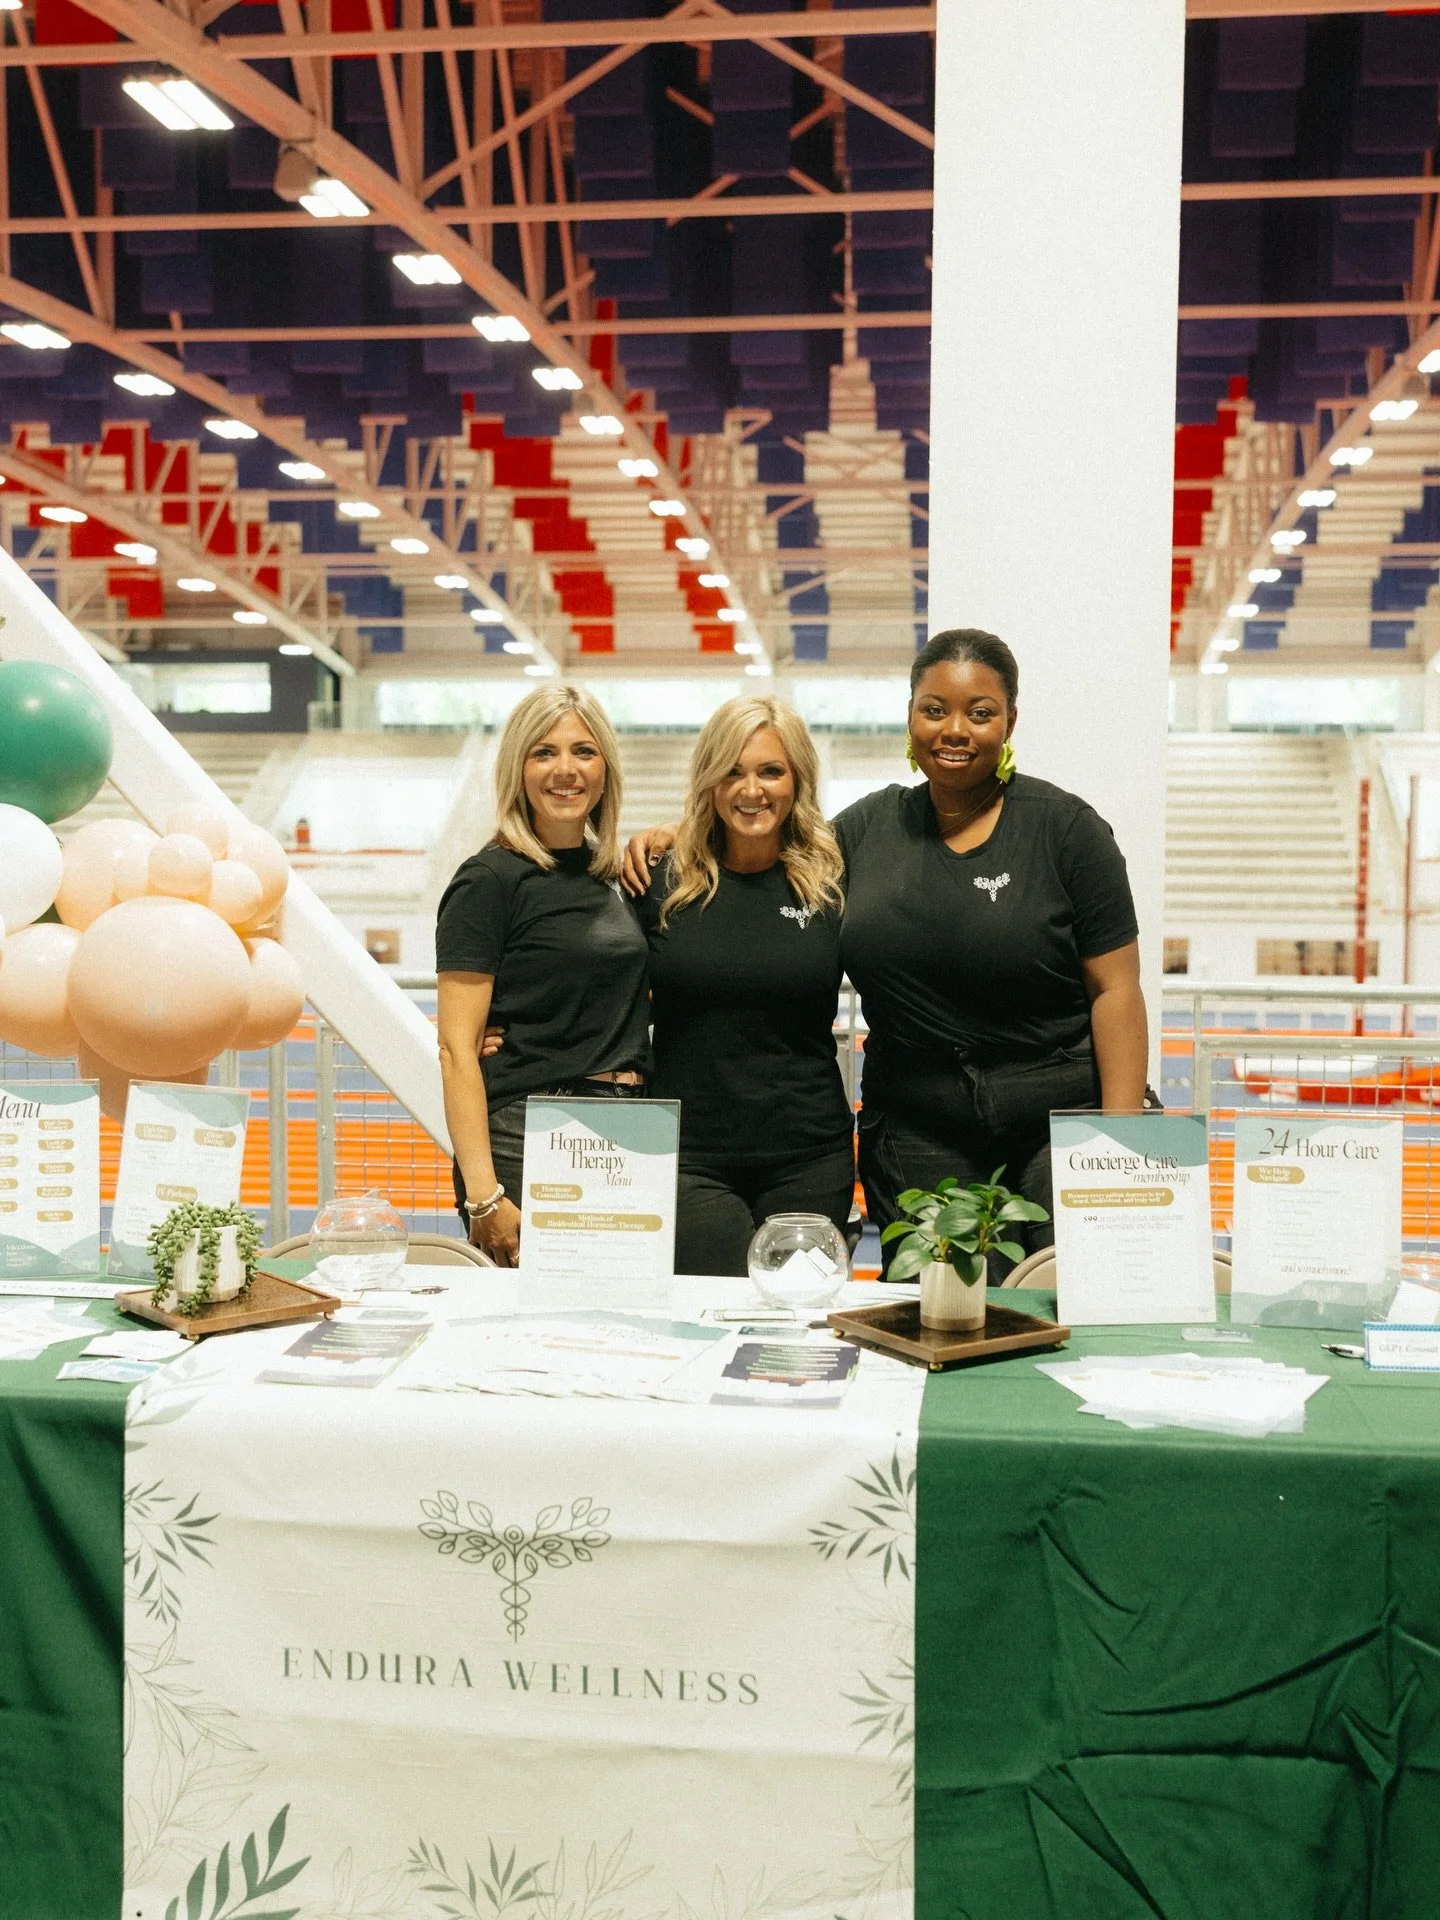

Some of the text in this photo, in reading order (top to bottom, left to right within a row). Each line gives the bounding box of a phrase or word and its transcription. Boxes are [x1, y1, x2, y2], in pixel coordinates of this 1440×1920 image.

[550, 1132, 618, 1151] Hormone
[1258, 1127, 1380, 1160] 24 Hour Care
[568, 1150, 627, 1174] Therapy
[1069, 1150, 1179, 1175] Concierge Care
[604, 1173, 633, 1188] Menu
[1133, 1169, 1191, 1186] membership
[536, 1192, 577, 1200] Consultation
[282, 1647, 761, 1706] ENDURA WELLNESS
